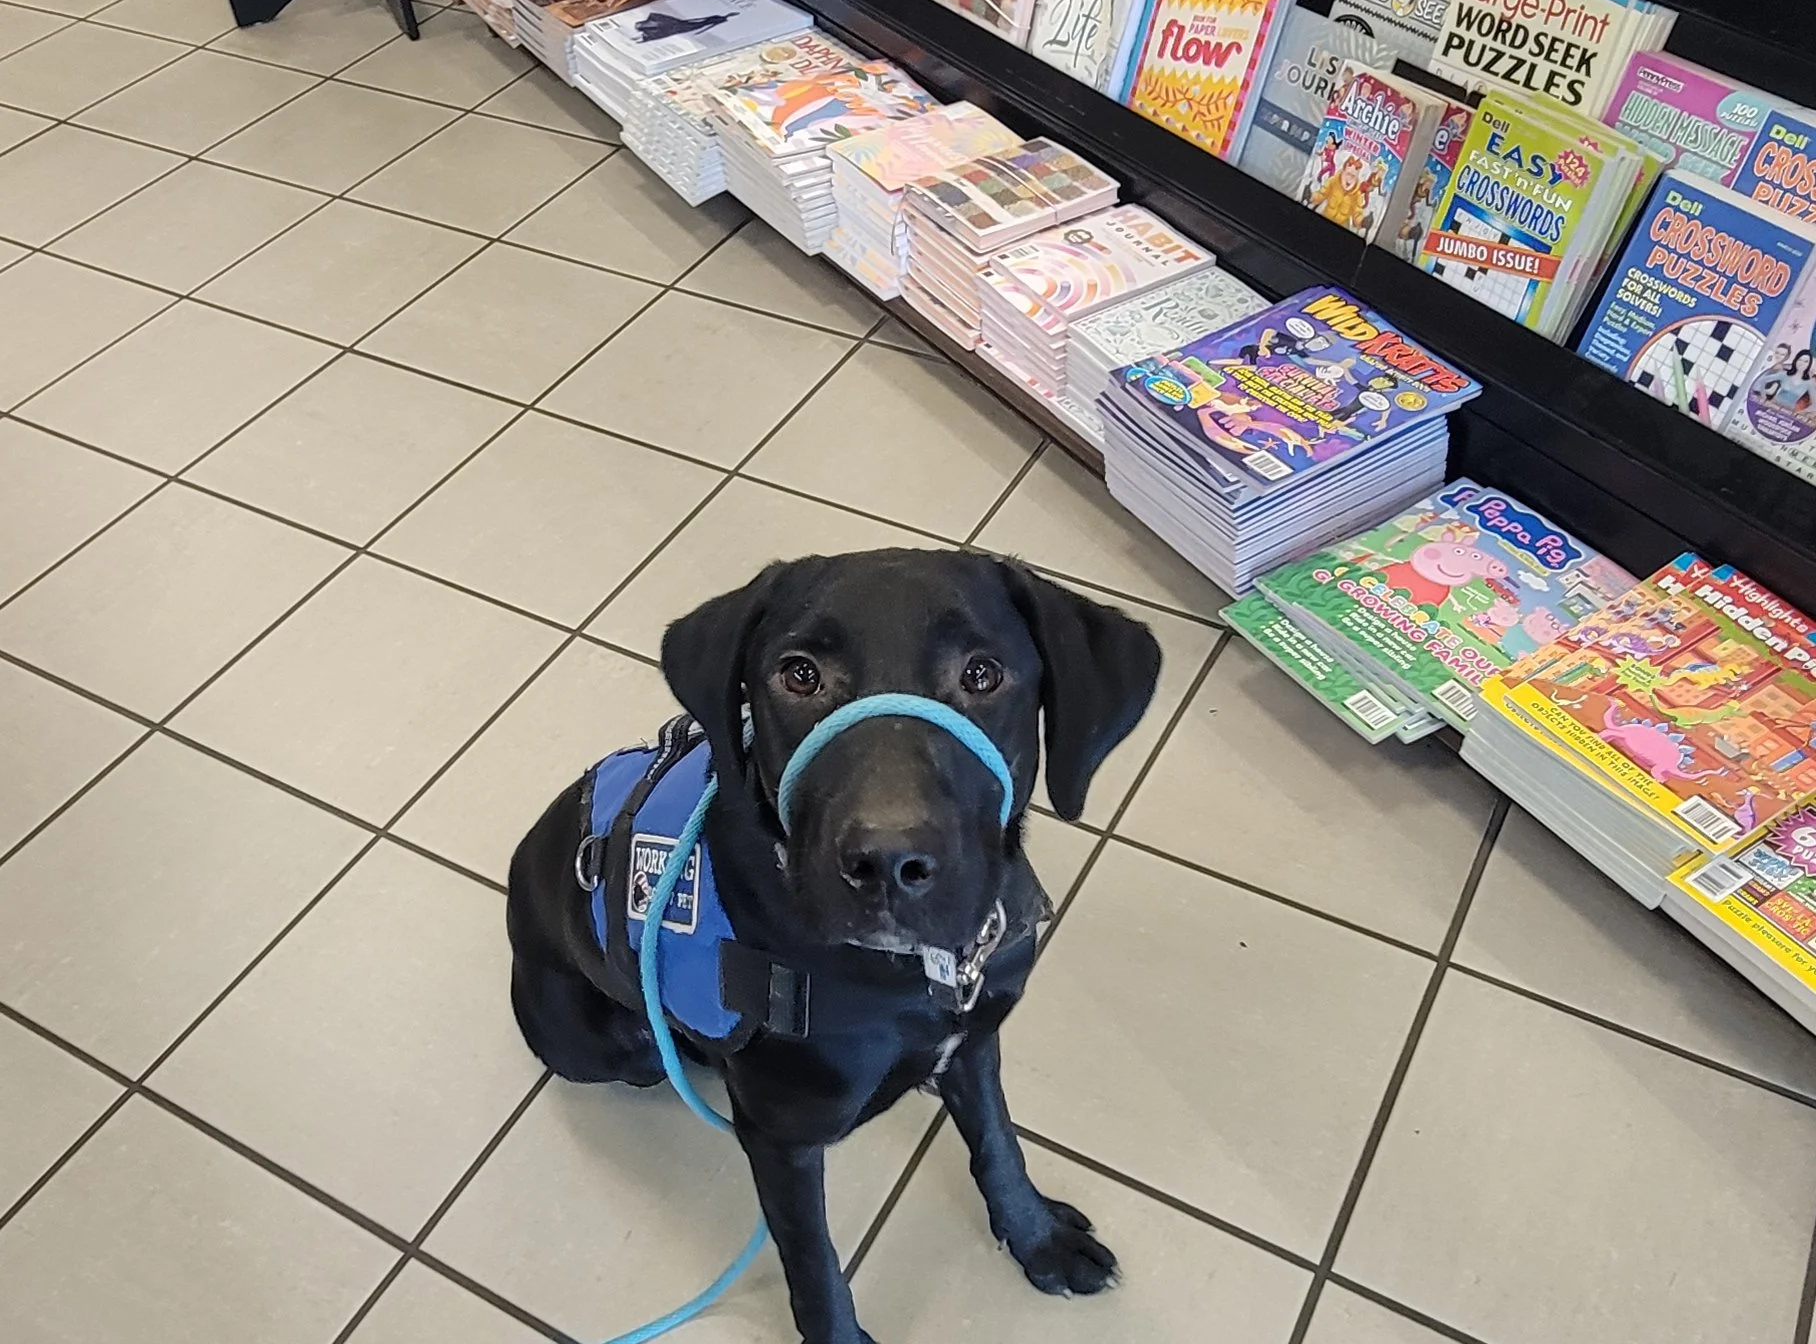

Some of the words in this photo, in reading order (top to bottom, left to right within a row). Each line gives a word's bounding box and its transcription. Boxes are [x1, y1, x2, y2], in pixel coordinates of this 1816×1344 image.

[1155, 17, 1243, 70] flow
[1188, 23, 1217, 38] PAPER
[1454, 2, 1530, 51] WORD
[1528, 31, 1599, 78] SEEK
[1305, 46, 1339, 76] LIS
[1441, 30, 1586, 107] PUZZLES
[1339, 78, 1401, 142] Archie
[1482, 111, 1511, 135] Dell
[1619, 90, 1678, 142] HIDDEN
[1670, 112, 1749, 169] MESSAGE
[1732, 102, 1760, 120] 100
[1768, 123, 1810, 150] Dell
[1343, 127, 1381, 154] WINTER
[1485, 130, 1565, 187] EASY
[1564, 151, 1585, 178] 124
[1456, 164, 1566, 244] CROSSWORDS
[1468, 149, 1514, 180] FAST
[1531, 183, 1573, 213] FUN
[1665, 190, 1704, 217] Dell
[1105, 221, 1169, 268] JOURNAL
[1108, 207, 1200, 266] HABIT
[1436, 235, 1489, 262] JUMBO
[1490, 248, 1541, 274] ISSUE!
[1649, 207, 1792, 298] CROSSWORD
[1616, 288, 1663, 319] SOLVERS!
[1621, 278, 1643, 295] FOR
[1640, 286, 1662, 304] ALL
[1626, 267, 1698, 309] CROSSWORDS
[1646, 244, 1763, 319] PUZZLES
[1301, 293, 1380, 342] WILD
[1353, 331, 1471, 394] KRATTS
[1478, 499, 1533, 545] Peppa
[1534, 534, 1568, 565] Pig
[1349, 611, 1369, 628] Ride
[1356, 607, 1387, 629] Design
[1391, 631, 1417, 652] house
[1358, 575, 1464, 650] CELEBRATE
[1694, 583, 1789, 654] Hidden
[1728, 574, 1809, 634] Highlights
[1337, 578, 1428, 642] GROWING
[1423, 638, 1485, 688] FAMIL
[1359, 630, 1384, 650] super
[1382, 647, 1413, 671] sibling
[1530, 701, 1568, 731] OBJECTS
[1565, 729, 1596, 754] HIDDEN
[1595, 751, 1609, 762] IN
[1607, 759, 1630, 777] THIS
[1549, 707, 1567, 723] CAN
[1567, 719, 1588, 736] YOU
[1586, 734, 1607, 751] FIND
[1605, 748, 1621, 763] ALL
[1620, 762, 1636, 773] OF
[1636, 771, 1654, 787] THE
[635, 846, 695, 881] WORKG
[676, 893, 694, 910] PET
[1722, 898, 1753, 924] Puzzle
[1751, 917, 1793, 955] pleasure
[1792, 951, 1808, 967] for
